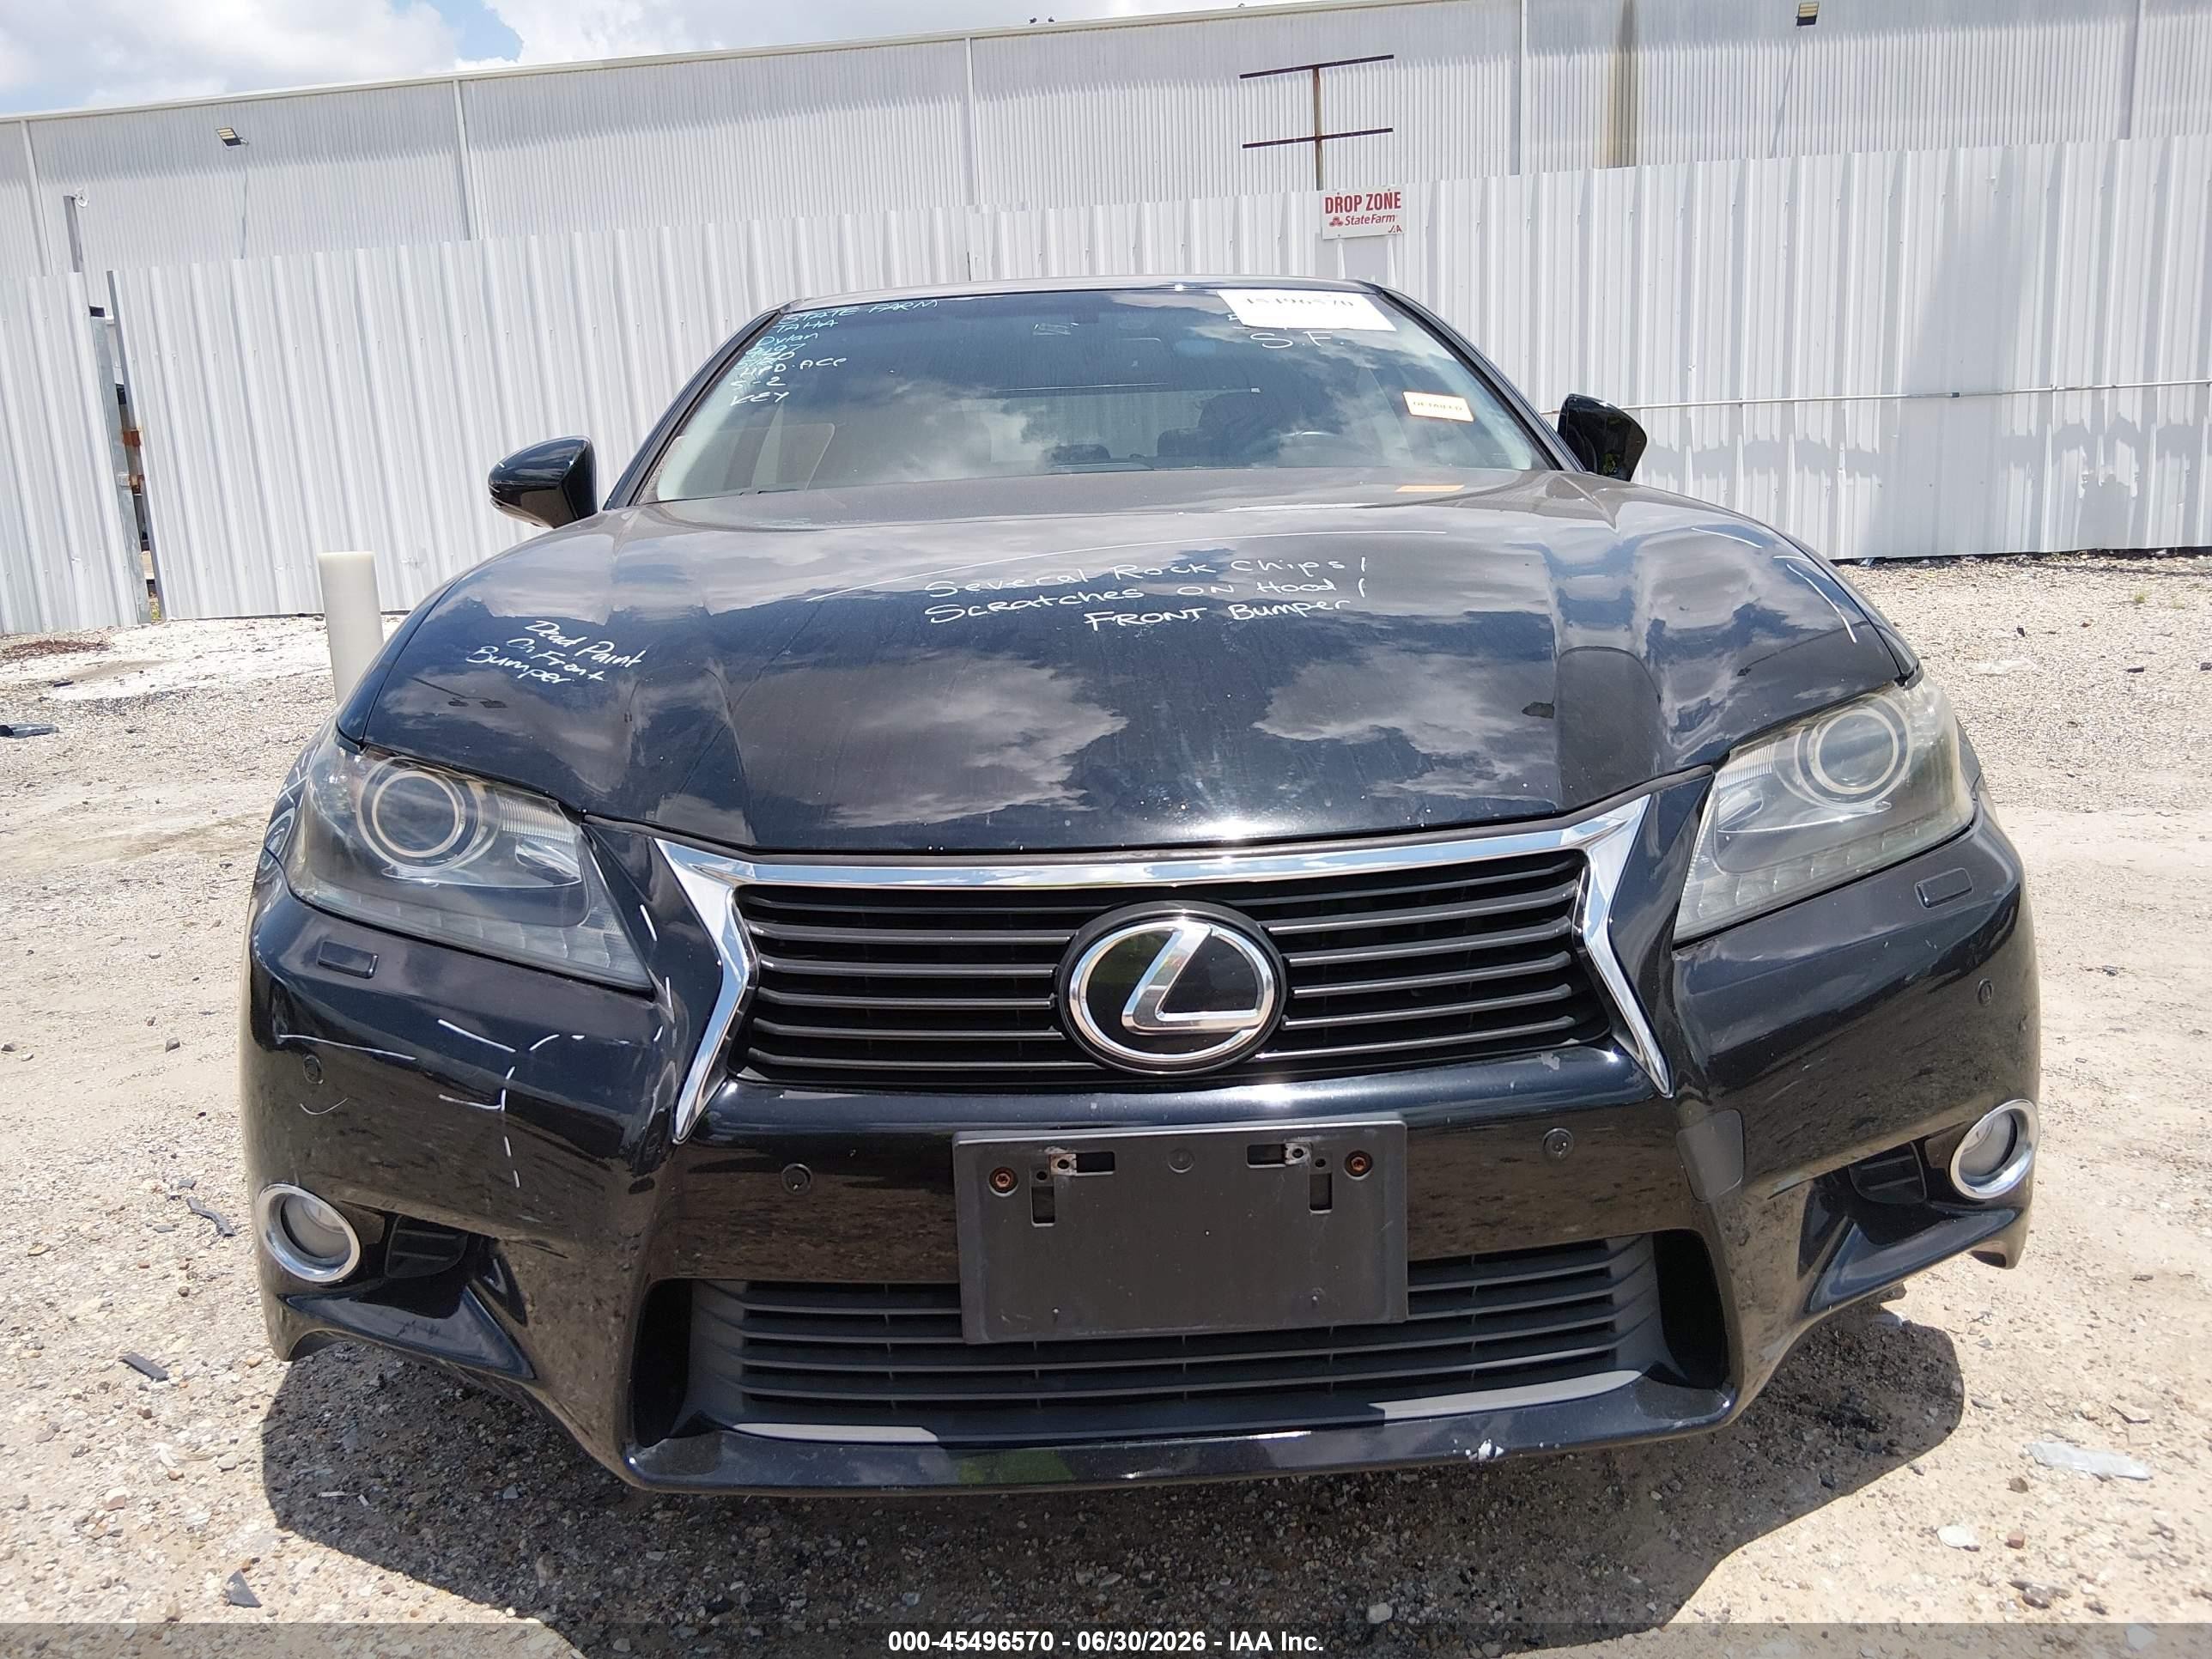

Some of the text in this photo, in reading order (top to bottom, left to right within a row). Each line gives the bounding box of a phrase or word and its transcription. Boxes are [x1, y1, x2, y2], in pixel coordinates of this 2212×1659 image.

[1325, 191, 1401, 215] DROP ZONE
[778, 299, 939, 325] STATE FARM
[730, 391, 790, 406] KEY
[924, 568, 1089, 598] Several
[1111, 562, 1217, 580] Rock
[1231, 559, 1346, 578] Chips
[1256, 578, 1337, 594] Hood
[1084, 599, 1351, 631] FRONT Bumper
[465, 646, 572, 684] Bumper
[530, 650, 605, 682] Front
[574, 641, 647, 668] Paint
